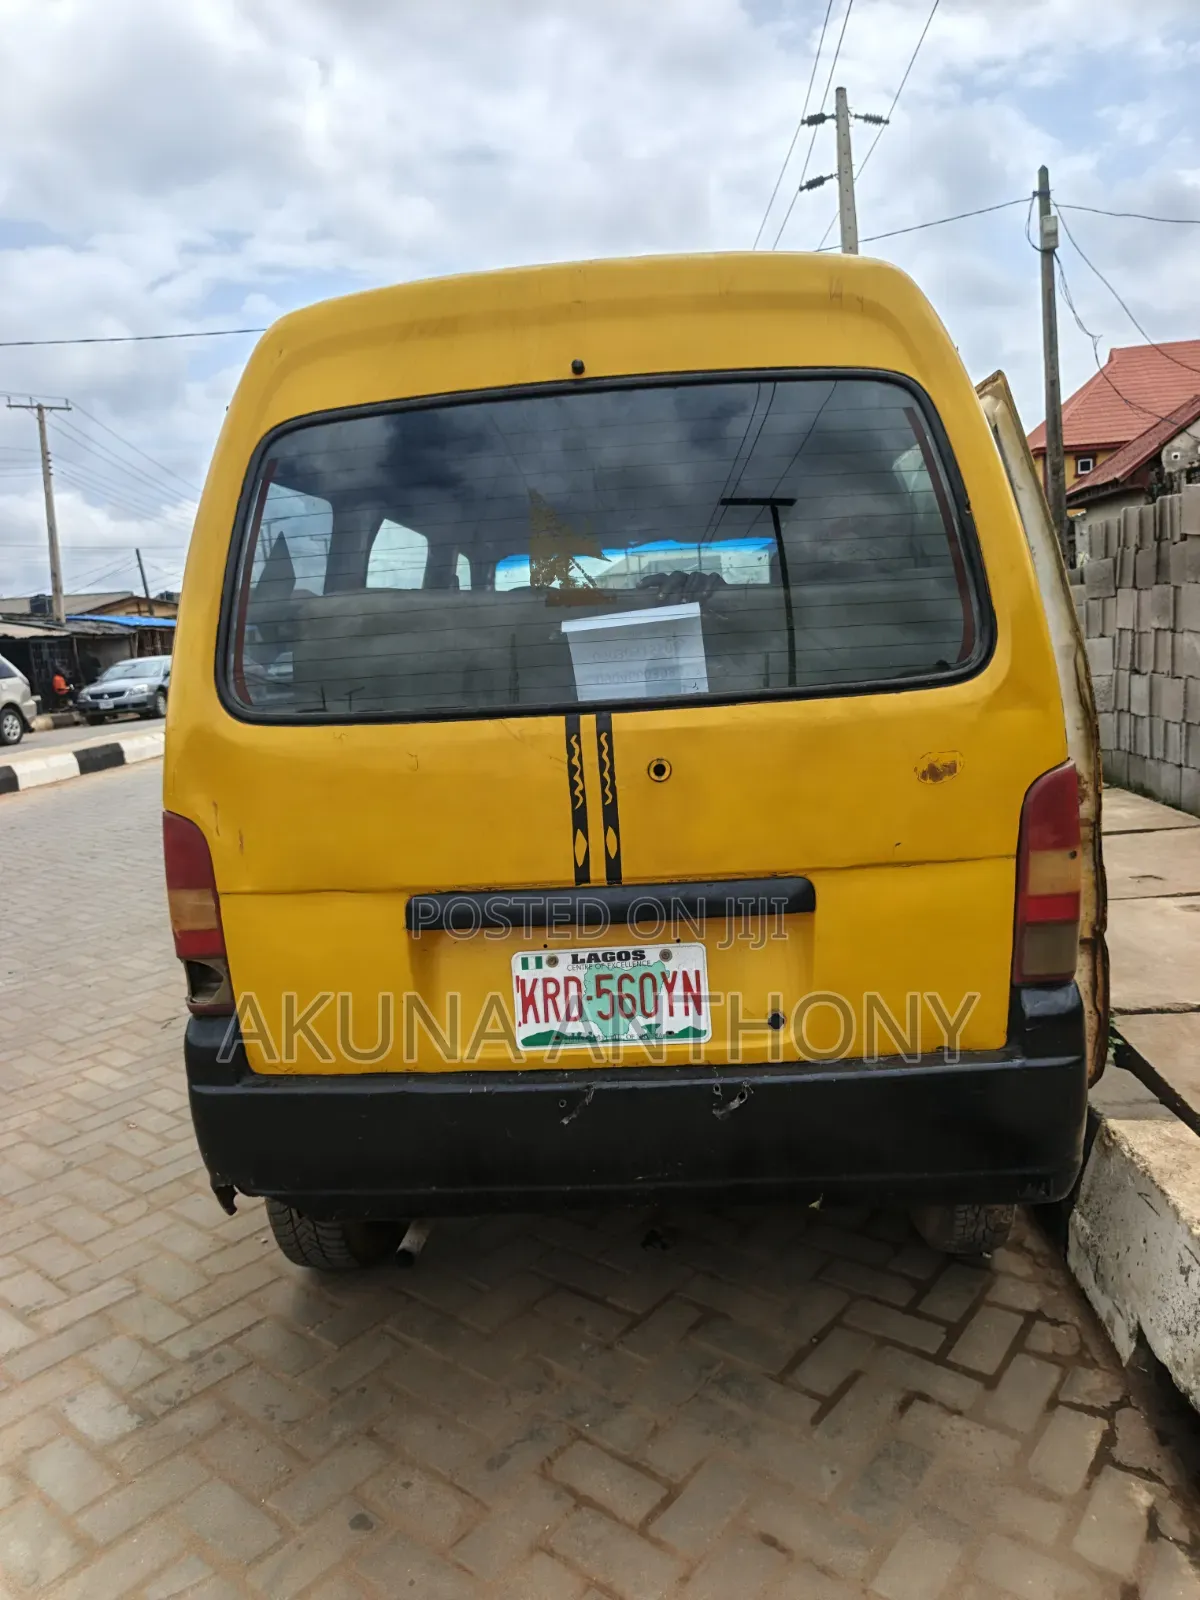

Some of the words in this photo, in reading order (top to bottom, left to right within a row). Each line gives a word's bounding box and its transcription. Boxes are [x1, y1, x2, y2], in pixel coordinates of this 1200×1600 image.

[571, 950, 646, 964] LAGOS
[566, 963, 593, 972] CENTRE
[594, 963, 604, 971] OF
[607, 960, 651, 970] EXCELLENCE
